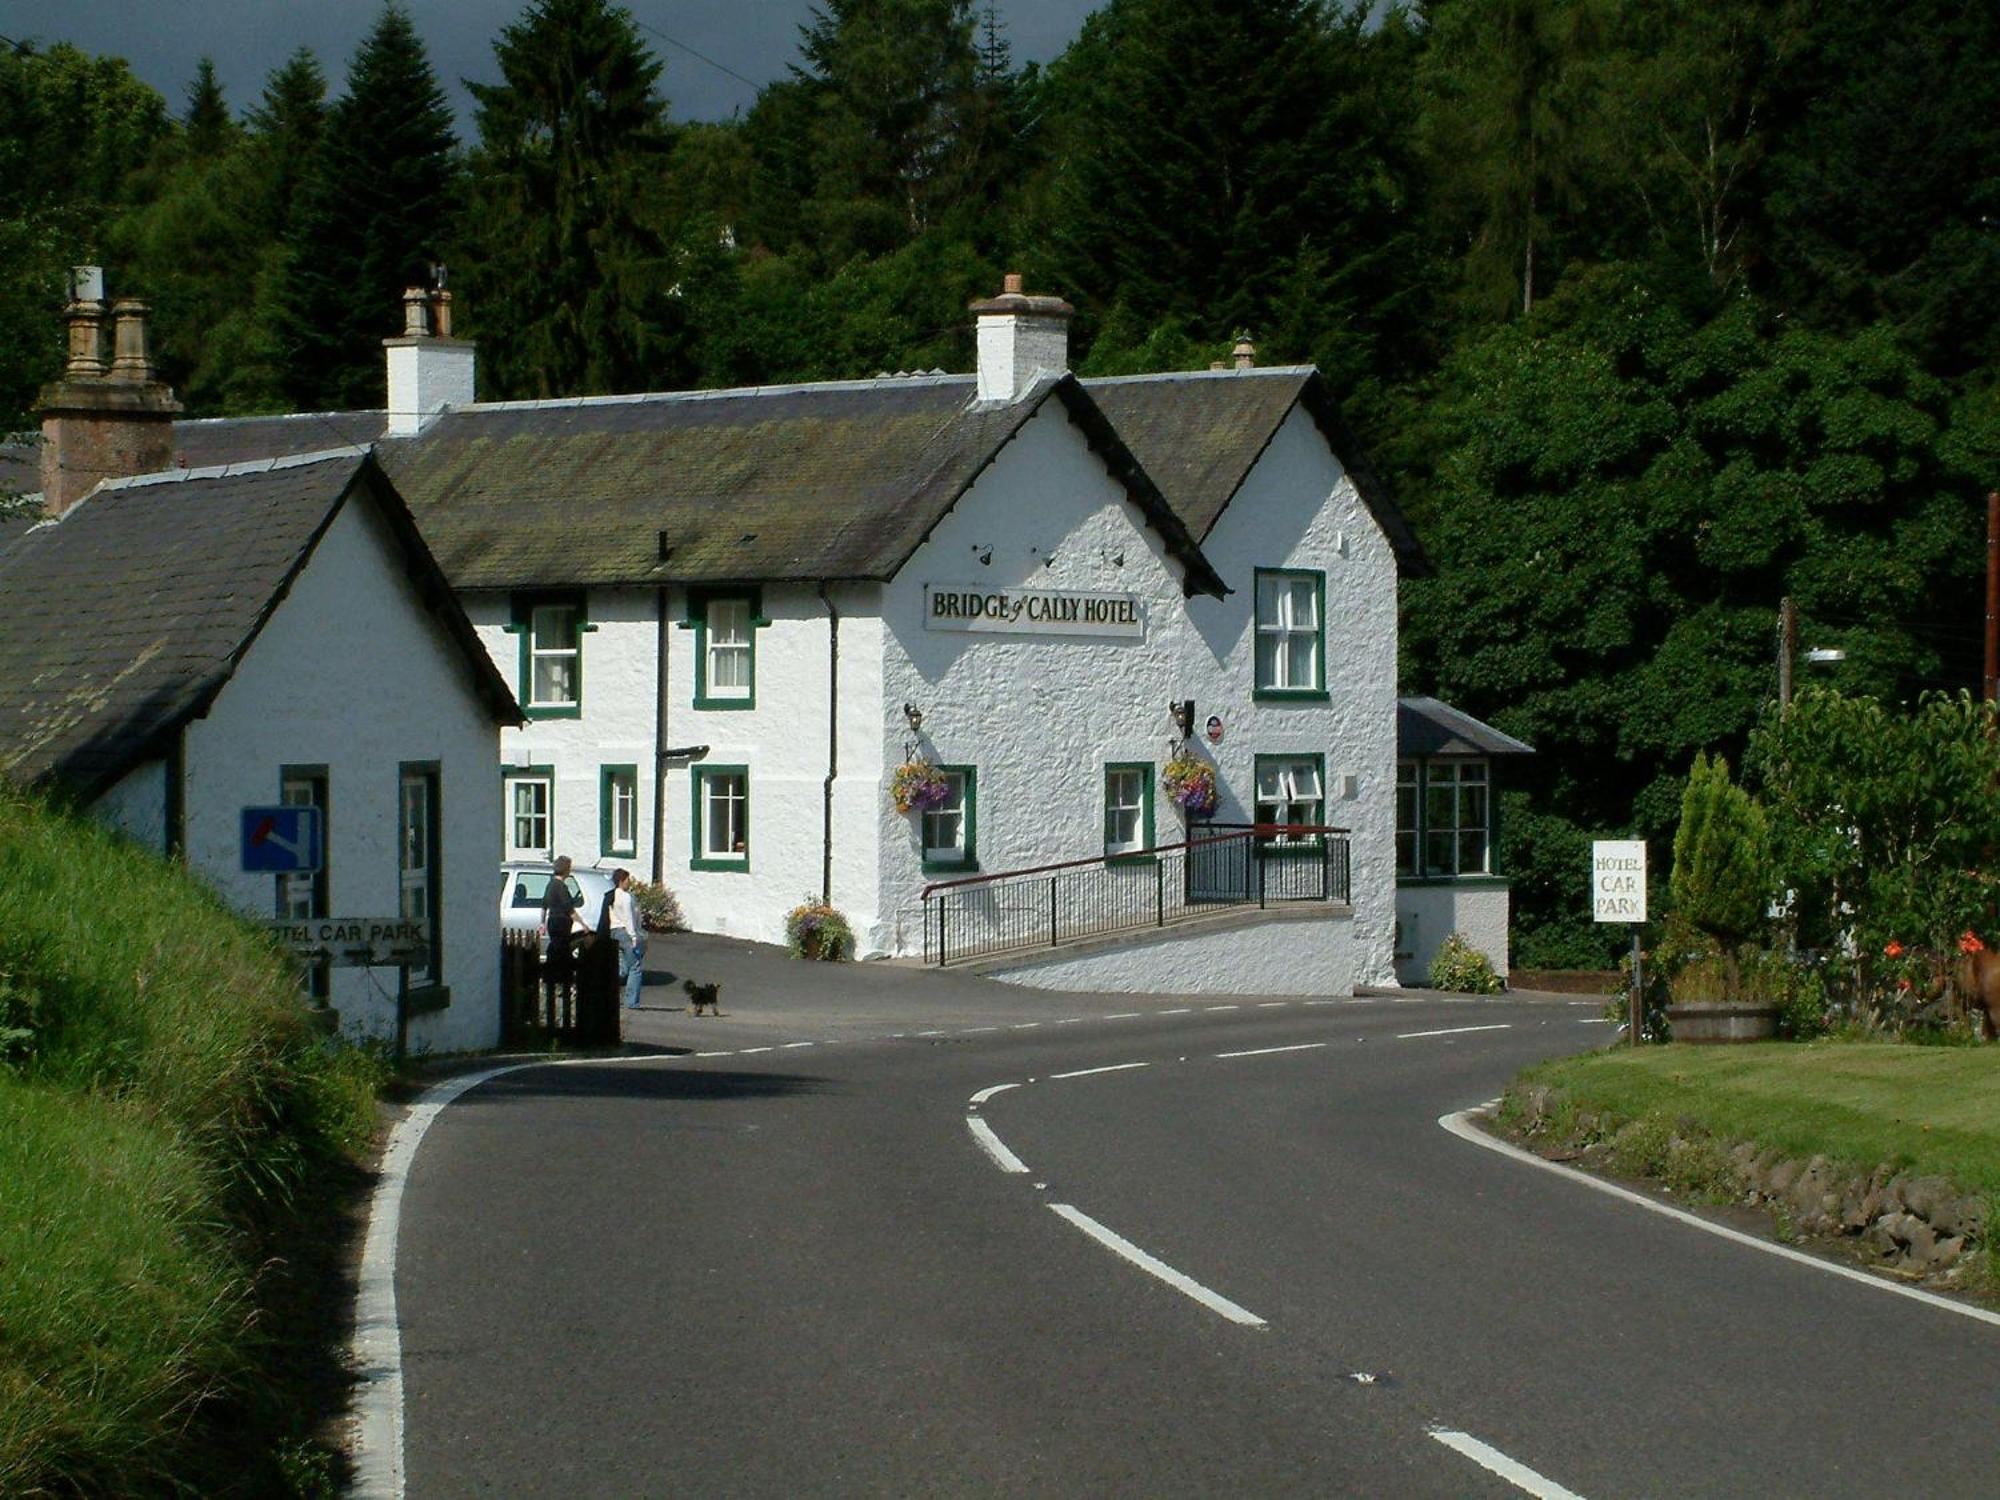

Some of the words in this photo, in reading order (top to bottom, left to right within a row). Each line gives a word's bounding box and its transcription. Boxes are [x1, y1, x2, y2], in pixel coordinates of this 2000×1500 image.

[933, 592, 1009, 618] BRIDGE
[1009, 595, 1028, 623] of
[1028, 596, 1081, 622] CALLY
[1085, 599, 1138, 624] HOTEL
[1596, 857, 1643, 871] HOTEL
[1600, 876, 1636, 892] CAR
[1596, 897, 1639, 914] PARK
[320, 925, 361, 941] CAR
[370, 925, 423, 941] PARK
